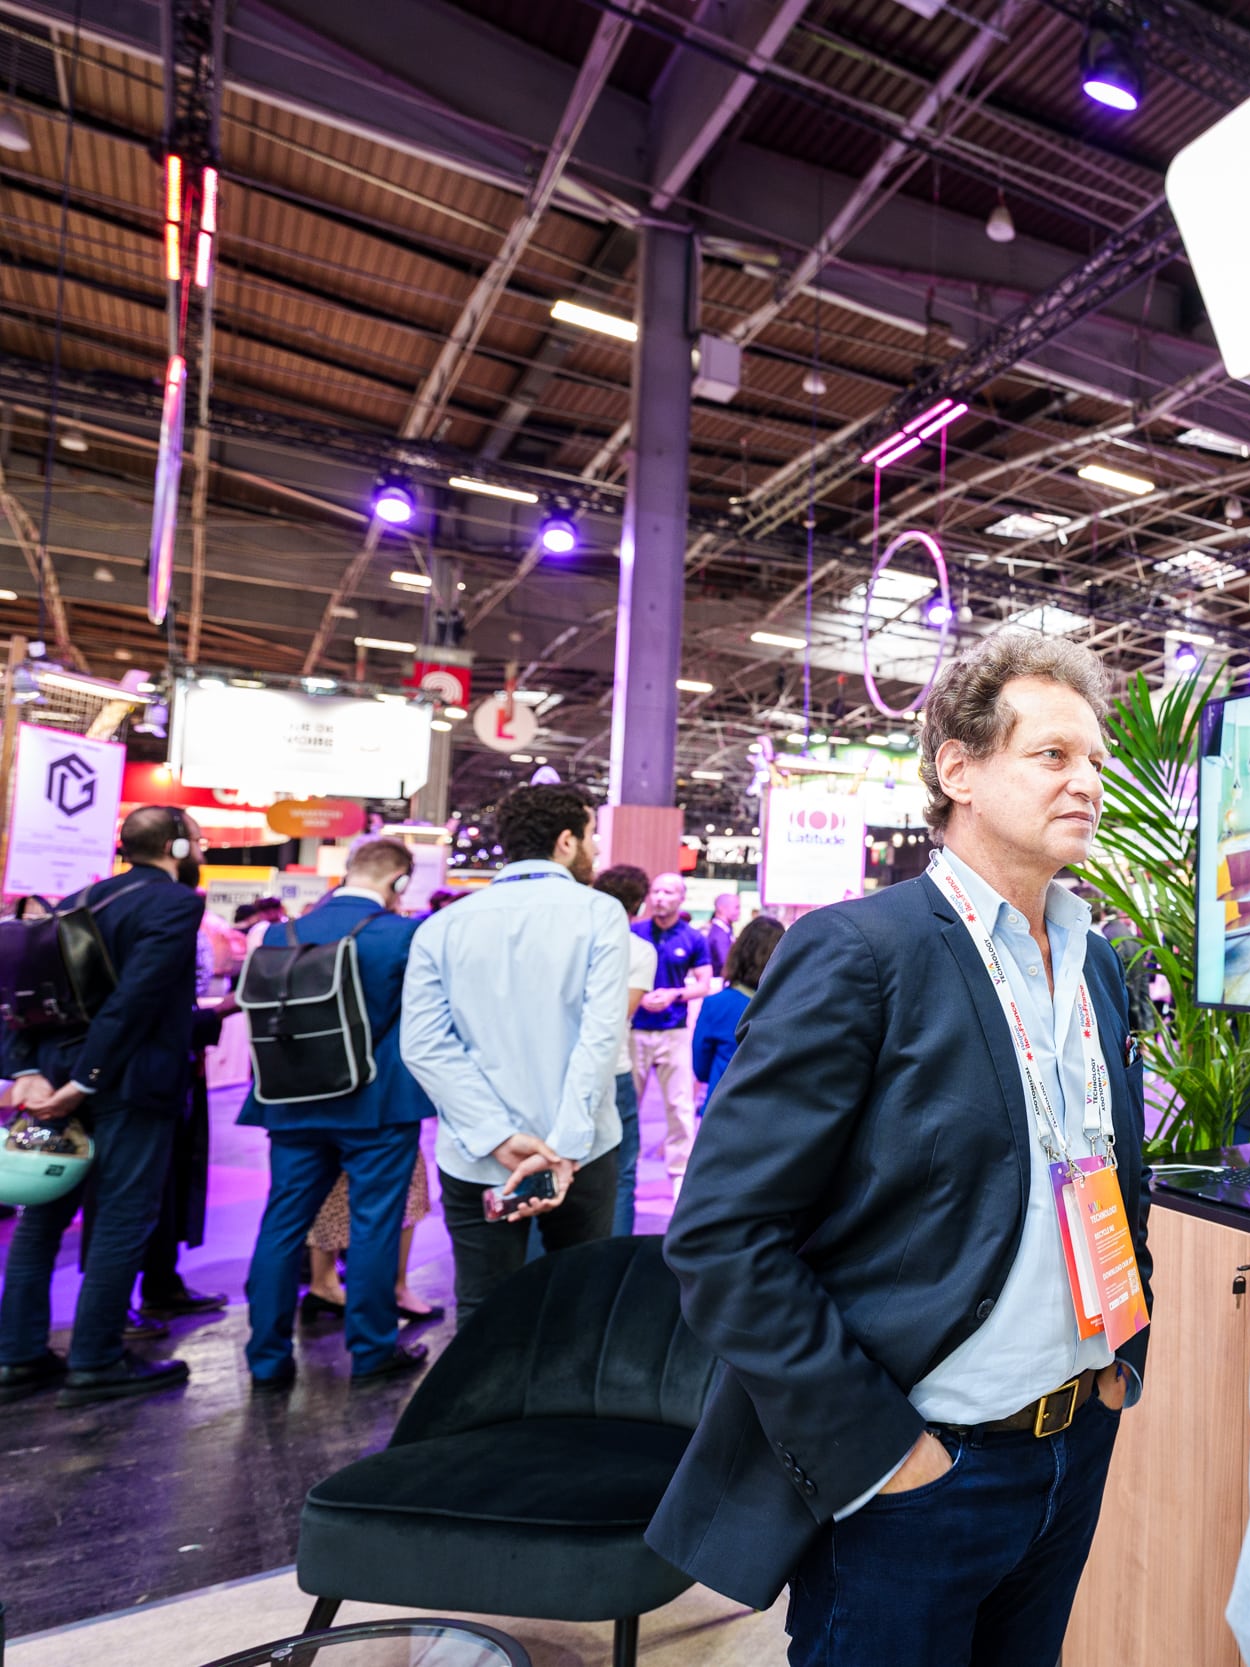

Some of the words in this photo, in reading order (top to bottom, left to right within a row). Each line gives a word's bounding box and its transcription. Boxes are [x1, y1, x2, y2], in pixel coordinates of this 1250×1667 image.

[787, 831, 846, 845] Latitude
[984, 939, 1006, 983] TECHNOLOGY
[1025, 1066, 1040, 1116] TECHNOLOGY
[1090, 1058, 1098, 1105] TECHNOLOGY
